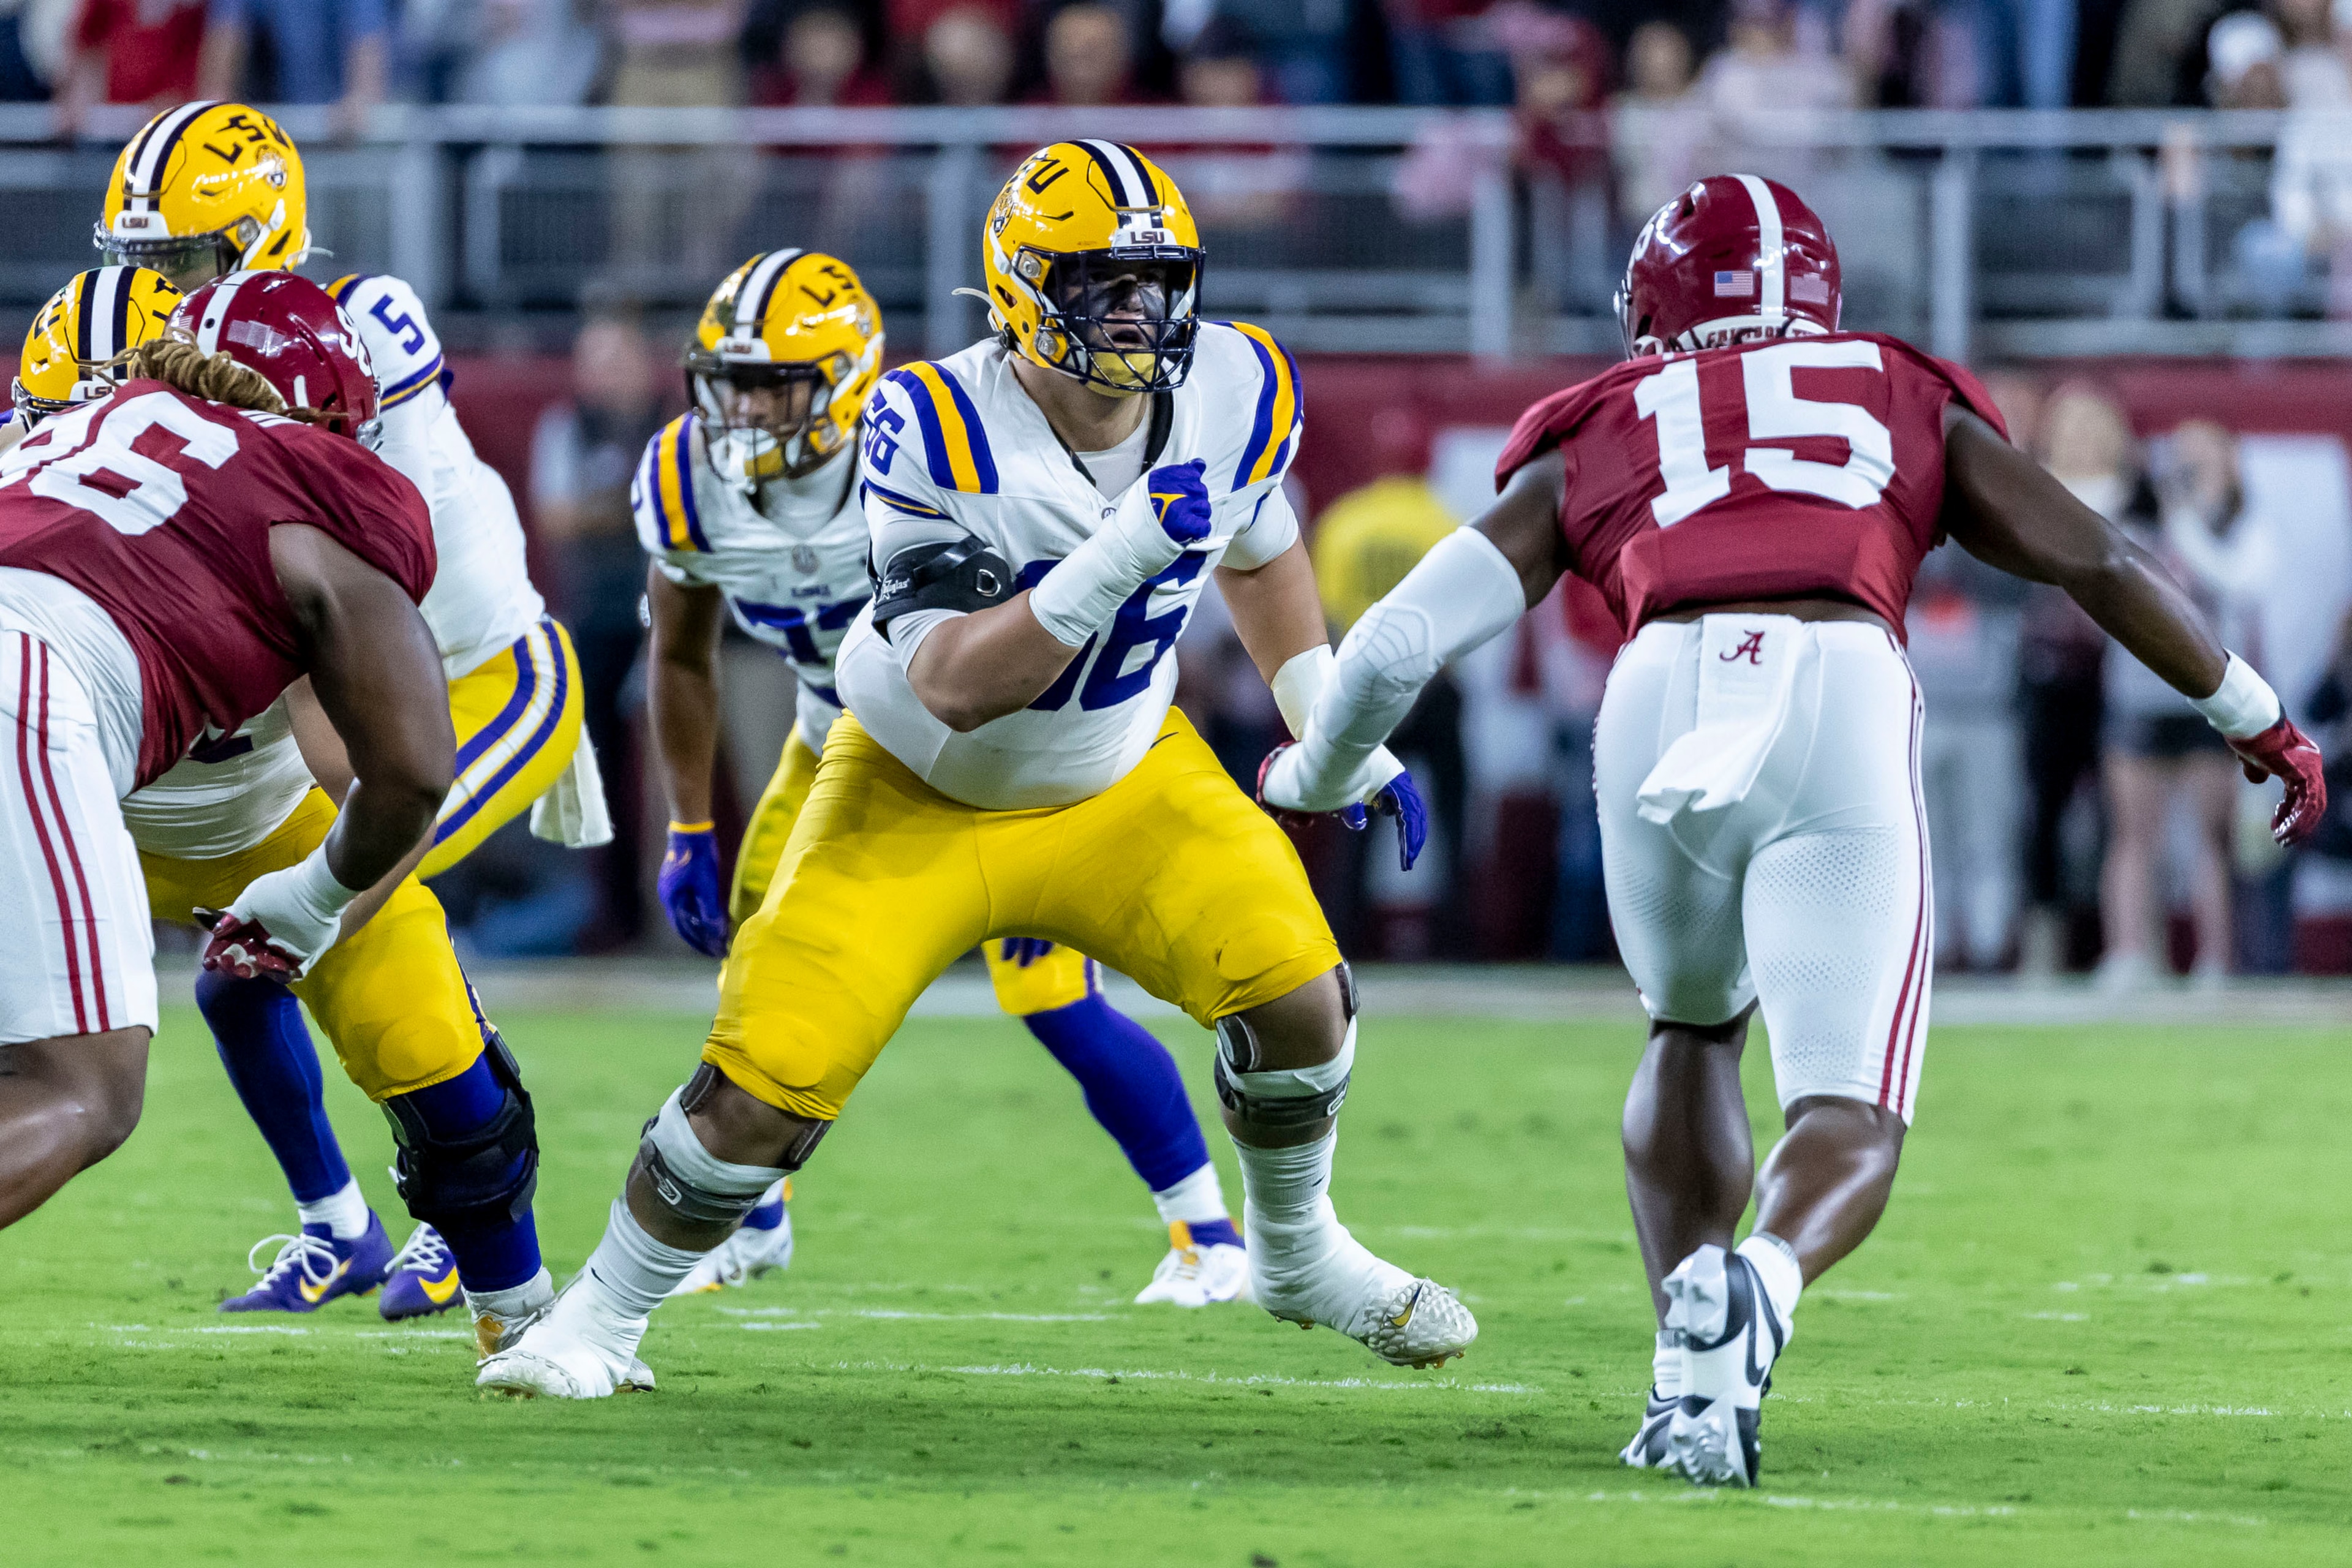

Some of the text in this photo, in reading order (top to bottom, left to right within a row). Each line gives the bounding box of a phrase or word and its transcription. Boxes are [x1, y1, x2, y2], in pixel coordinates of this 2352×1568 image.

[1130, 231, 1165, 244] LSU
[369, 294, 426, 356] 5
[1633, 340, 1896, 529] 15
